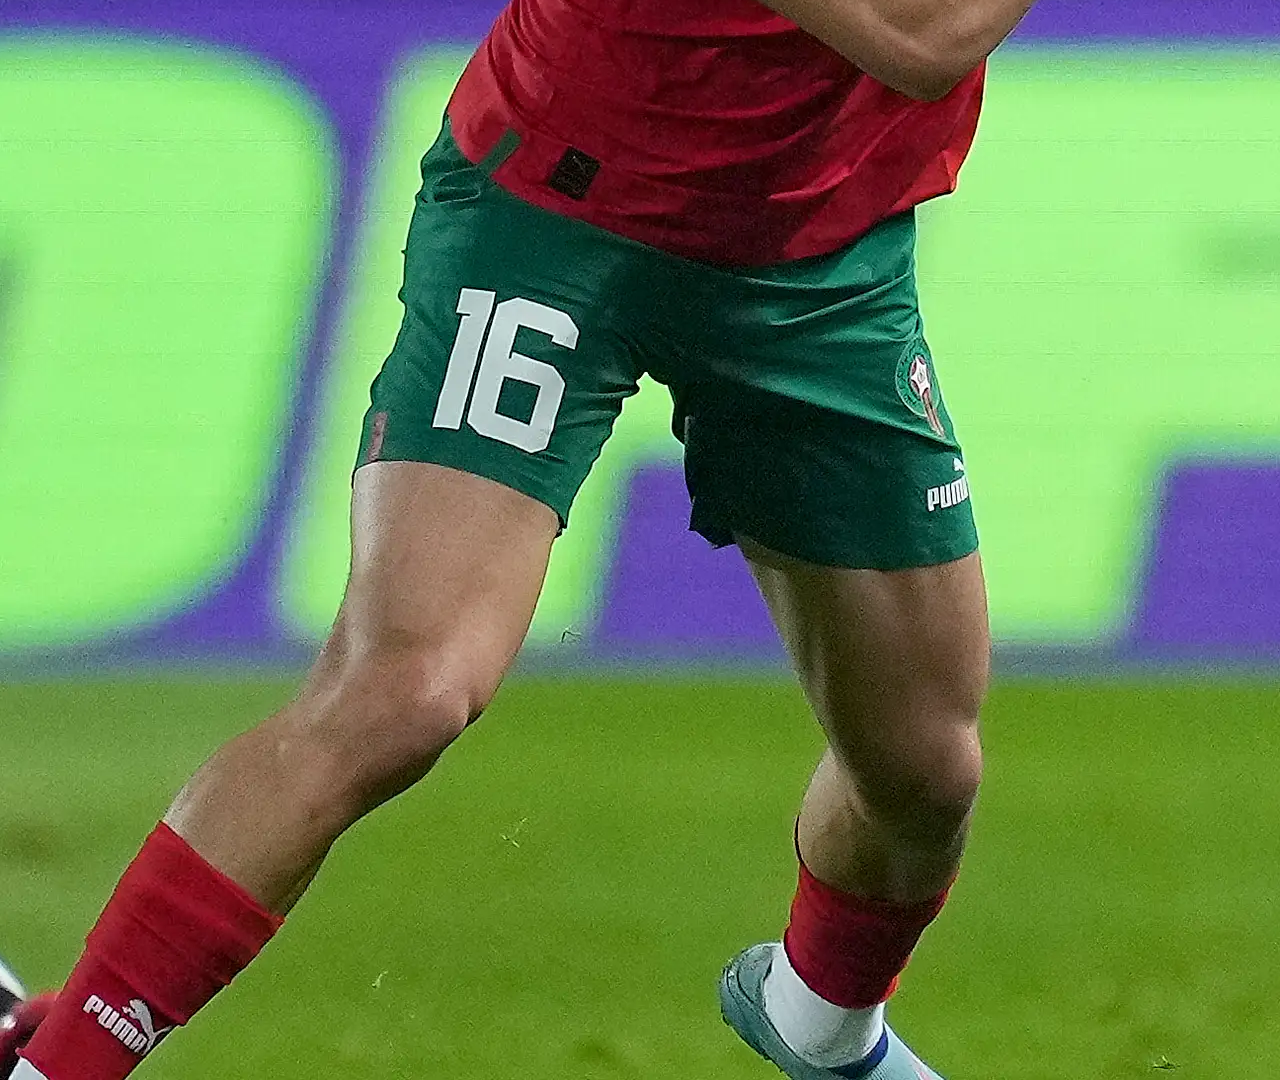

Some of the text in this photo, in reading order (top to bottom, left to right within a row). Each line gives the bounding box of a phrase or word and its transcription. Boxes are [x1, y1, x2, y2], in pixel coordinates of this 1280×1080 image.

[431, 286, 580, 455] 16
[926, 475, 969, 512] PUM
[82, 994, 148, 1053] PUMA
